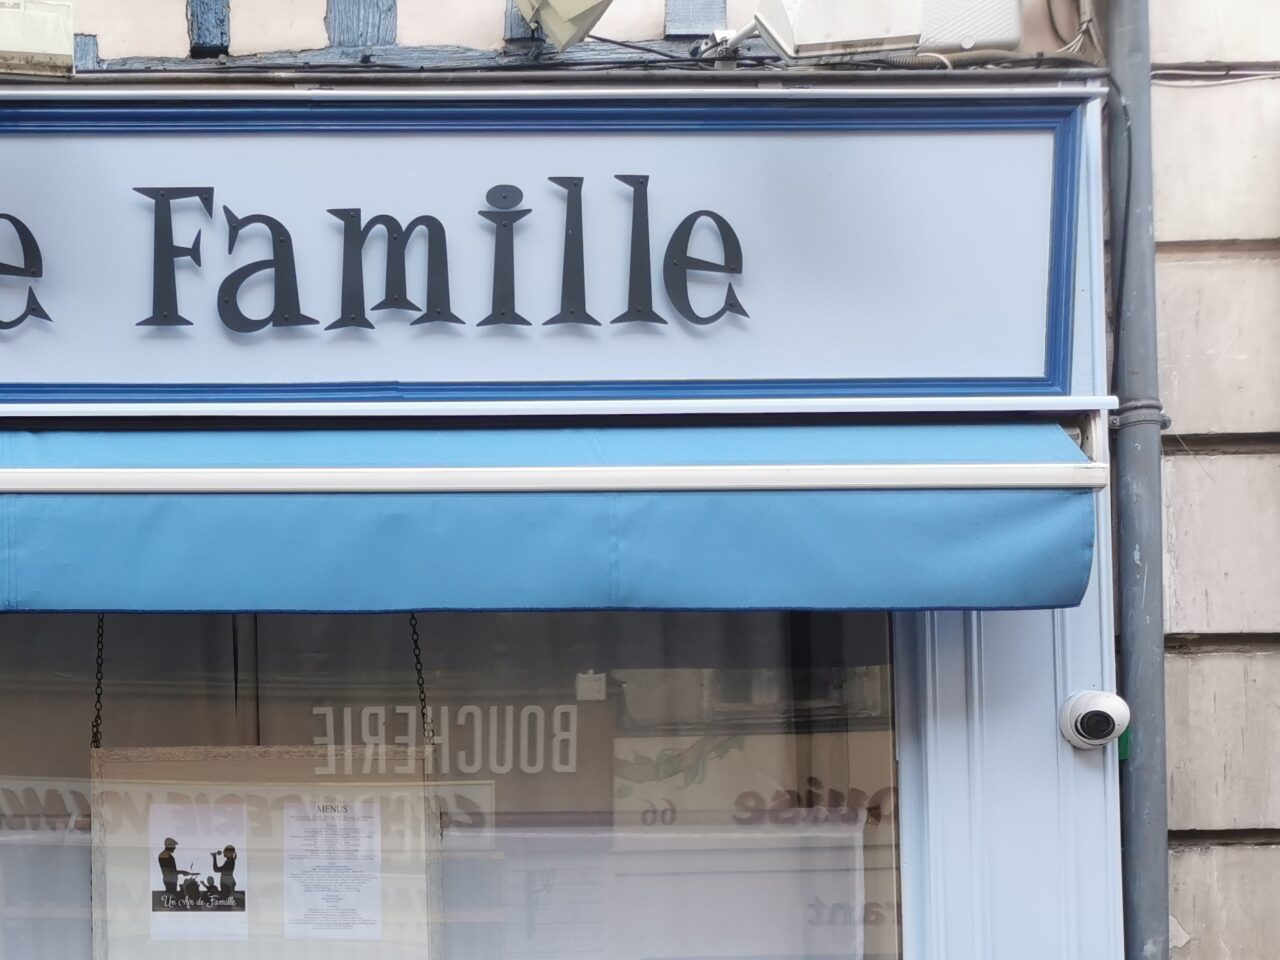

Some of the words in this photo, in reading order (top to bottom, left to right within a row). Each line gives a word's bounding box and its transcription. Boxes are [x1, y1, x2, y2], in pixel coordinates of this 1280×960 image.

[132, 174, 751, 333] Famille
[317, 804, 349, 814] MENUS
[161, 894, 177, 908] Un
[196, 895, 205, 907] de
[206, 893, 237, 908] Famille
